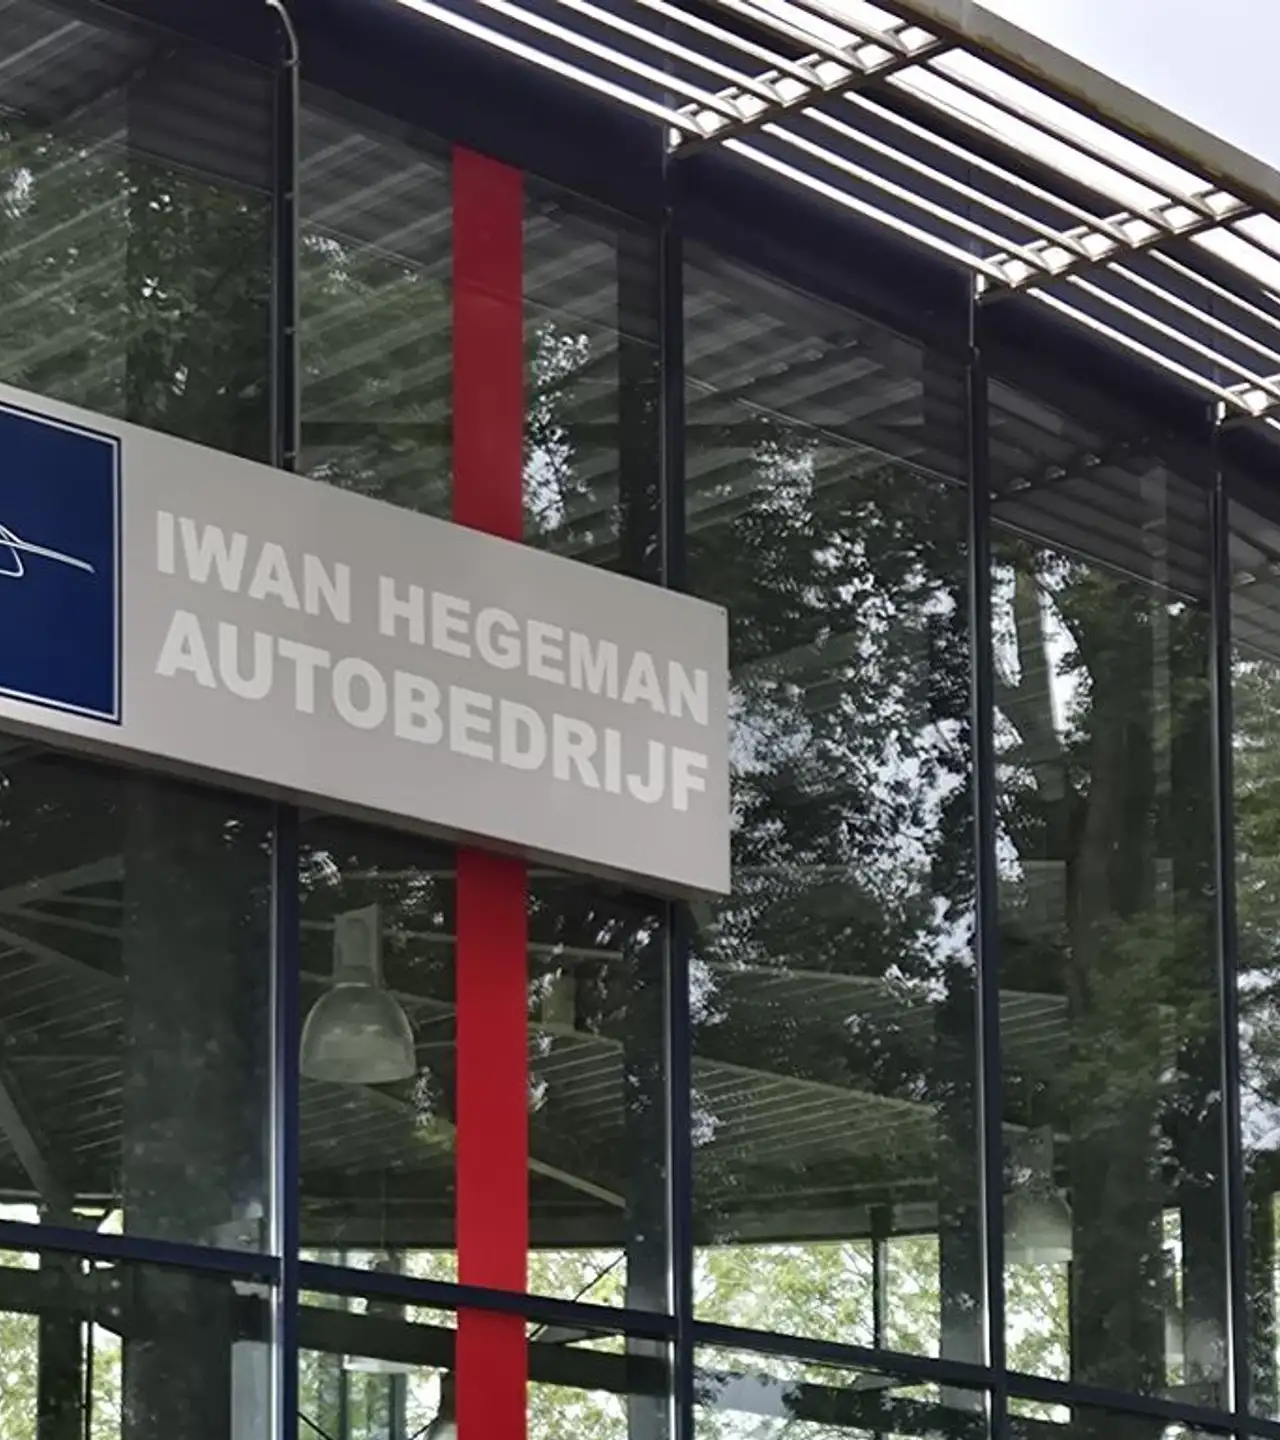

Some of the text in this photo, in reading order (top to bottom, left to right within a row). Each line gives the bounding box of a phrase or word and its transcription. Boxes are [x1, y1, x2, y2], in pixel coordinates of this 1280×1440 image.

[154, 608, 709, 813] AUTOBEDRIJF
[156, 509, 710, 727] IWAN HEGEMAN
